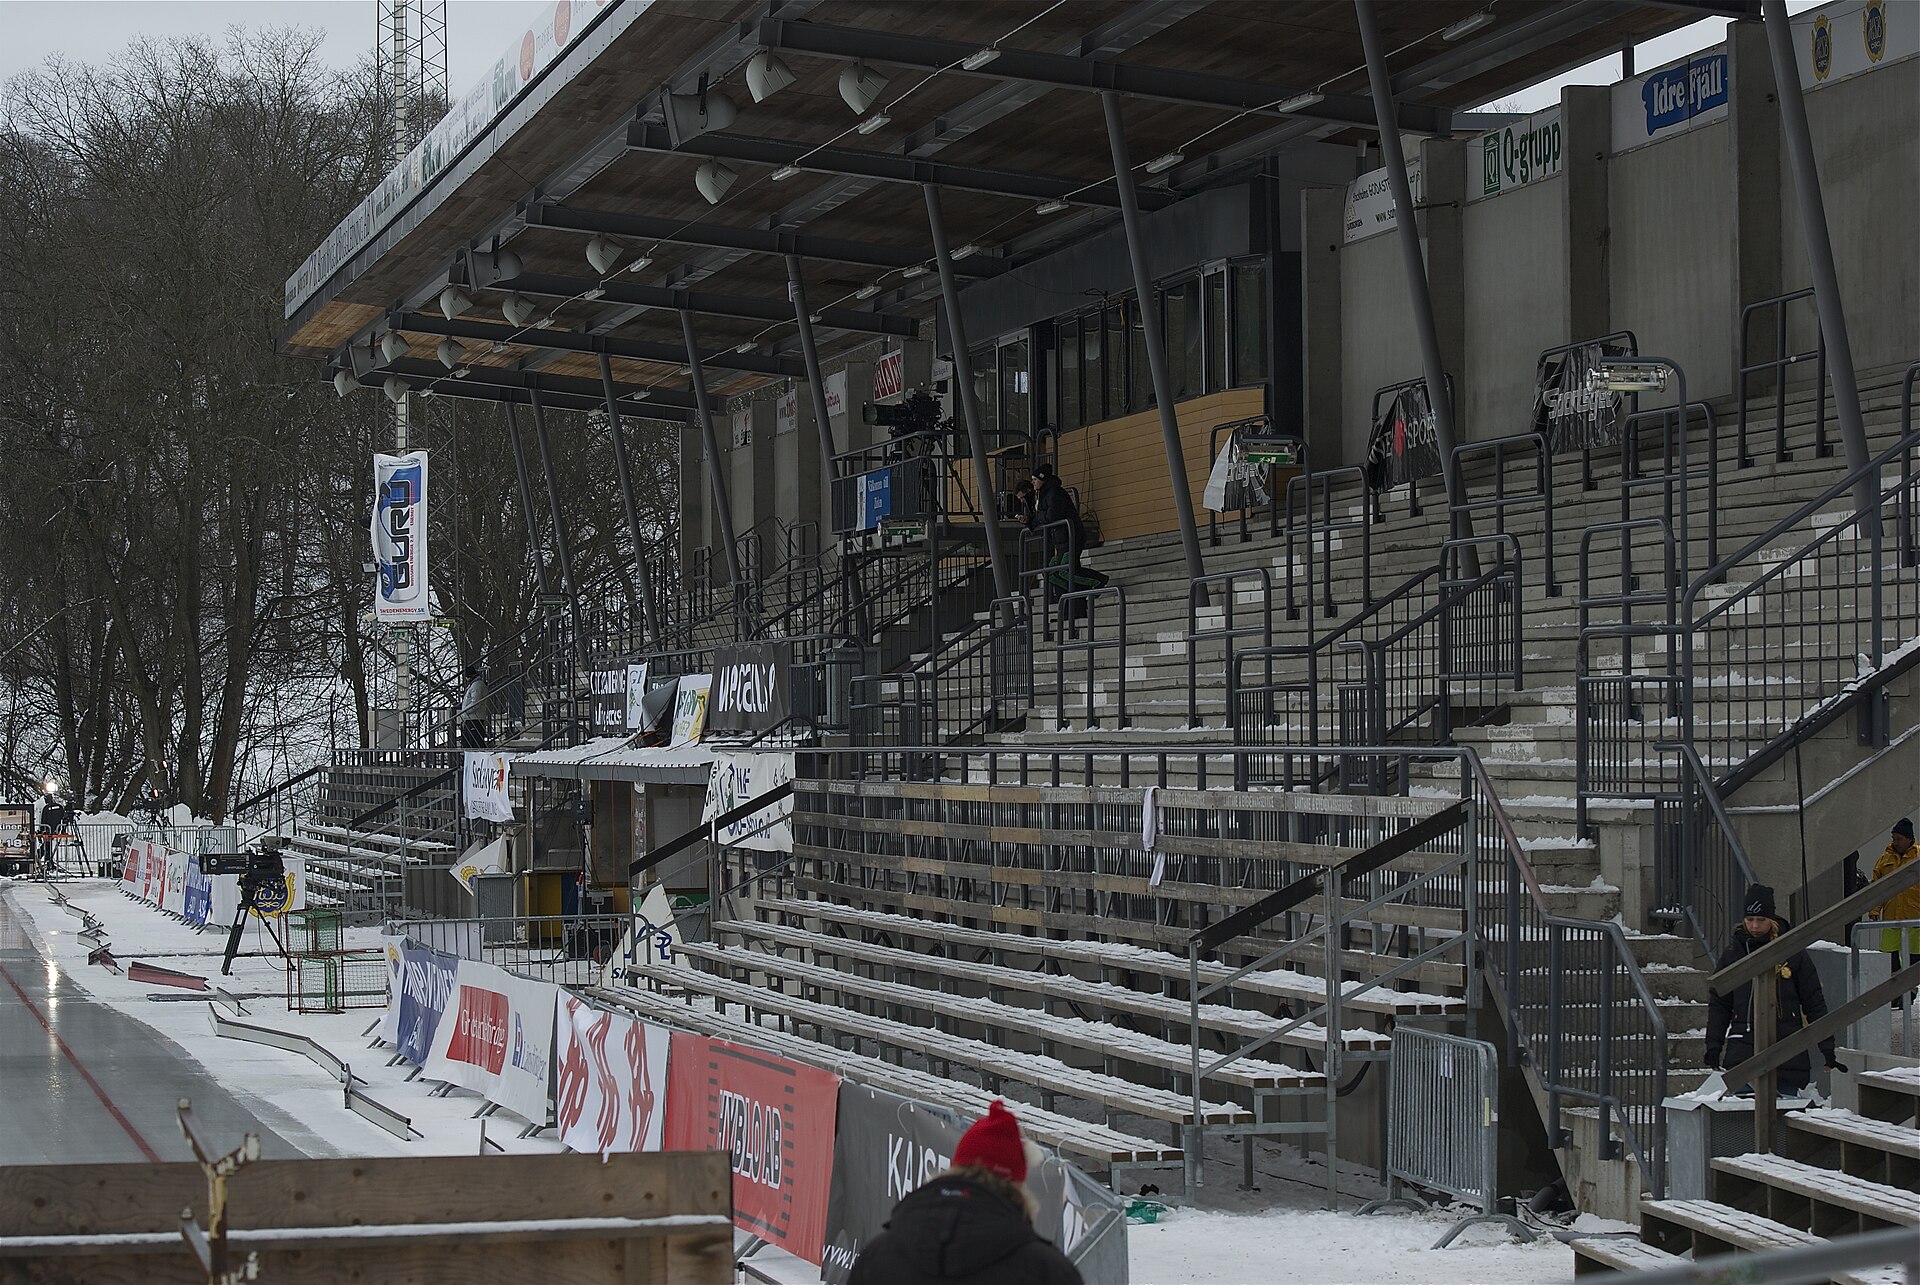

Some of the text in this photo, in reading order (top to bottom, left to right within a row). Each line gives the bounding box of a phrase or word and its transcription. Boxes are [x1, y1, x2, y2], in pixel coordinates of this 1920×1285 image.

[1653, 58, 1722, 116] Idre Fjäll
[391, 480, 410, 589] GURU
